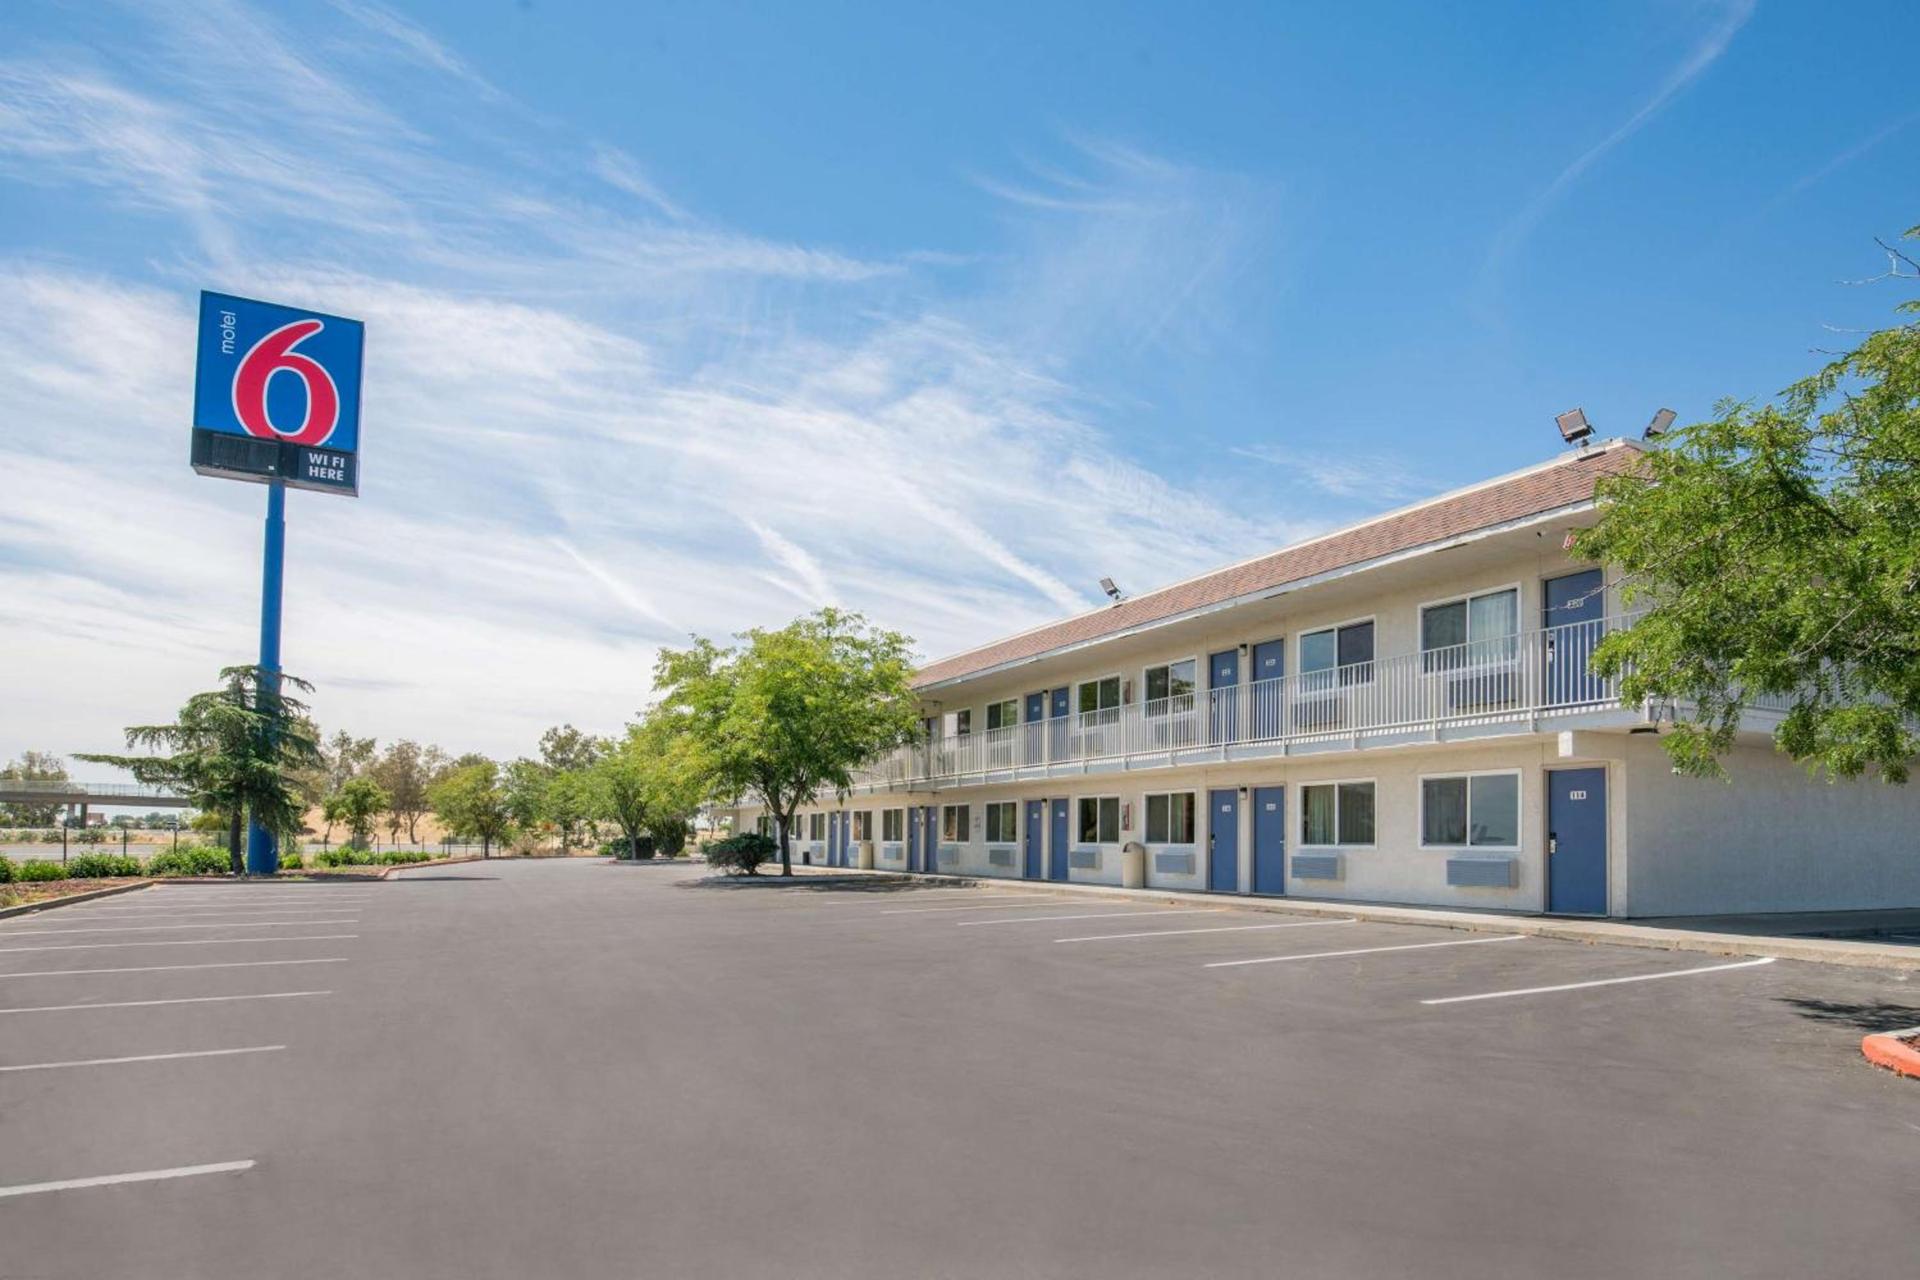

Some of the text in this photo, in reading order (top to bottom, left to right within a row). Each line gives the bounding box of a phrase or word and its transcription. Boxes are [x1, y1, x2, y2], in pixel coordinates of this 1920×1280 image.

[220, 310, 341, 447] motel 6
[308, 452, 345, 468] WI FI
[308, 466, 344, 481] HERE
